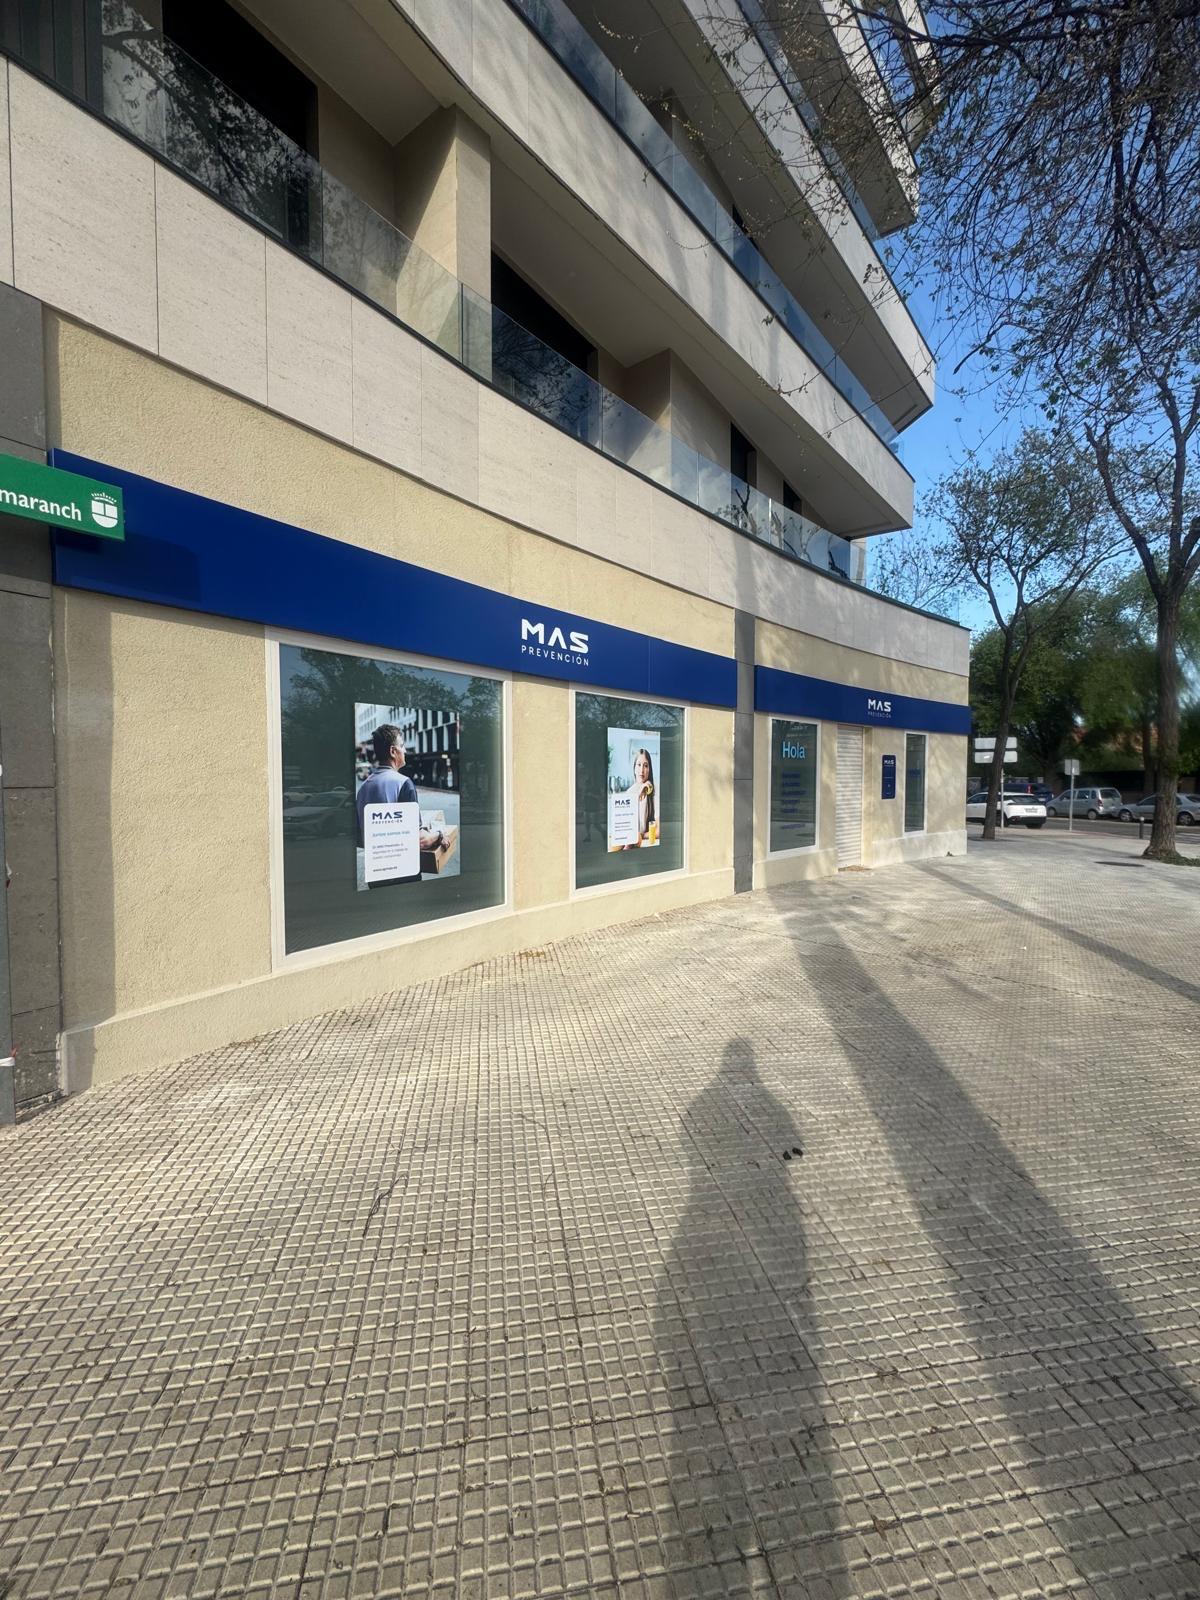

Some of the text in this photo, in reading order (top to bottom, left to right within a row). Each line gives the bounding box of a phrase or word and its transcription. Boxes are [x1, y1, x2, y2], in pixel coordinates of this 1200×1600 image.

[0, 489, 82, 521] maranch
[521, 618, 589, 654] MAS
[521, 645, 589, 667] PREVENCIÓN
[868, 698, 891, 712] MAS
[782, 741, 805, 759] Hola
[372, 811, 403, 820] MAS
